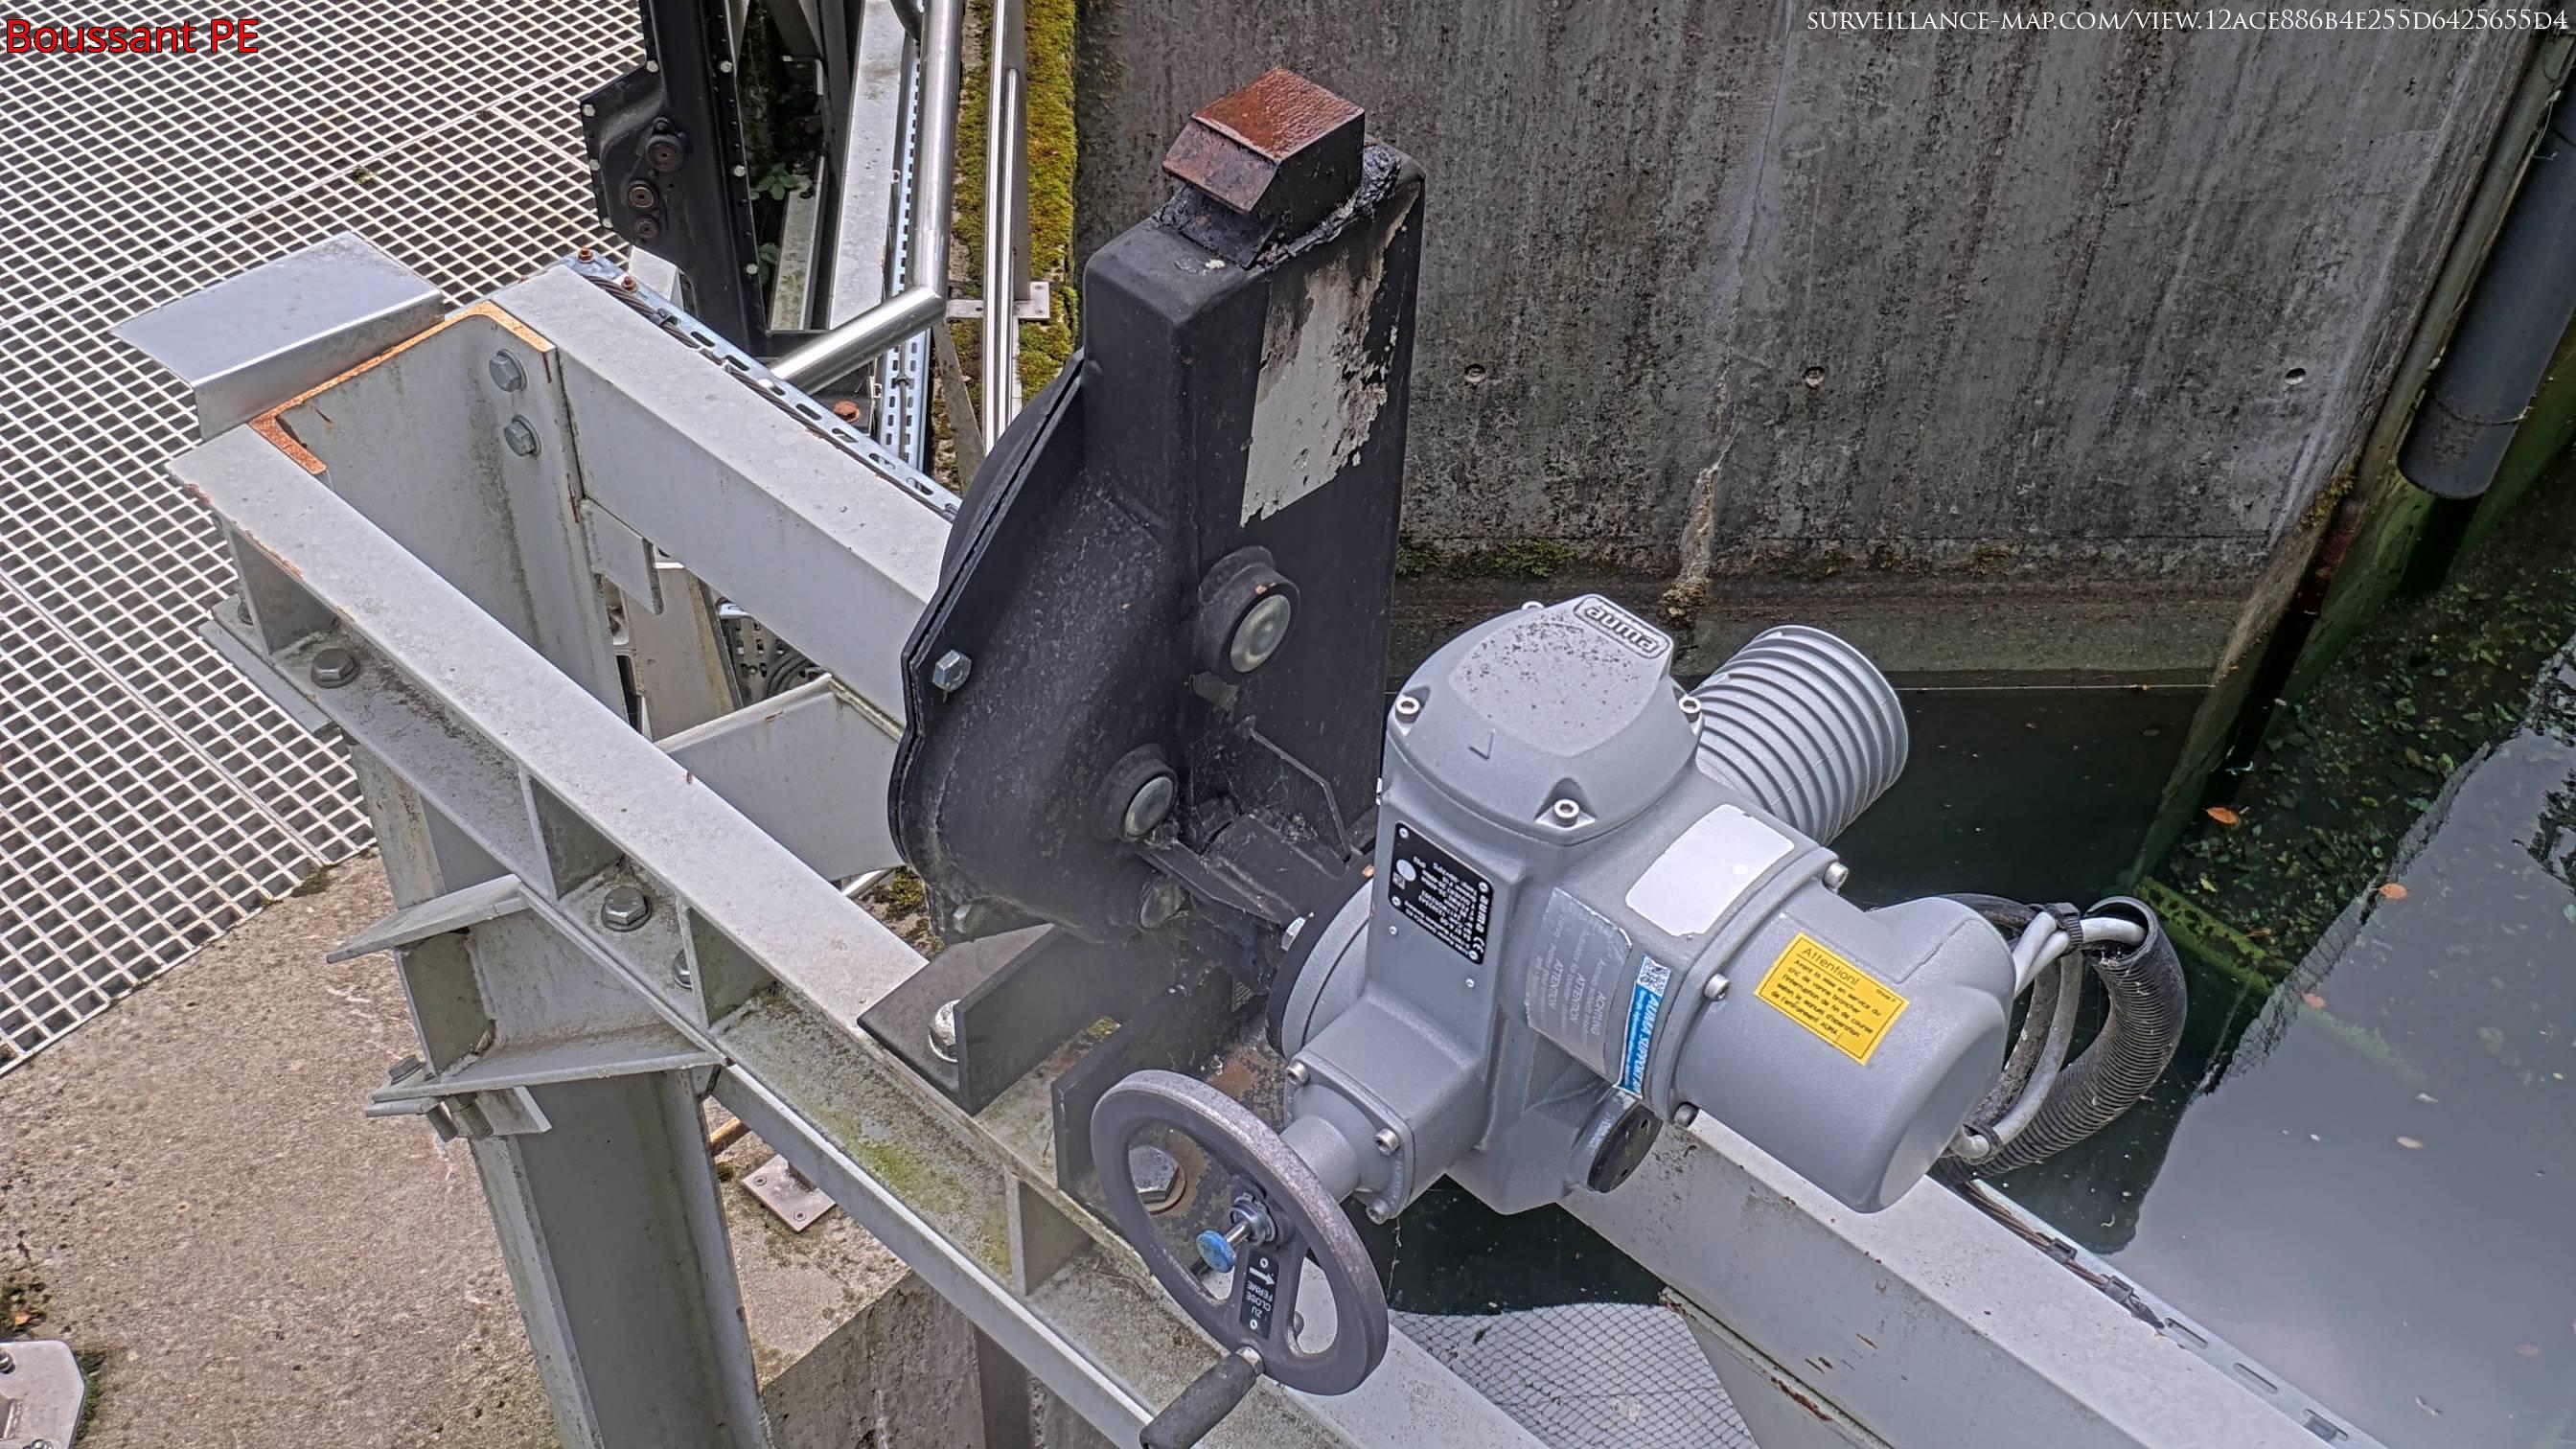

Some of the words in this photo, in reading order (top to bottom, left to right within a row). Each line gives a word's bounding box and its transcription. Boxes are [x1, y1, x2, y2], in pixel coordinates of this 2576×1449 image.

[1584, 605, 1660, 653] auma
[1475, 892, 1488, 934] auma
[1545, 956, 1564, 1010] ATTENTION
[1800, 945, 1860, 986] Attention!
[1568, 971, 1586, 1024] ATTENTION
[1770, 989, 1781, 999] de
[1792, 958, 1813, 974] Avant
[1846, 992, 1871, 1010] service
[1871, 1007, 1881, 1017] du
[1801, 974, 1811, 983] de
[1810, 981, 1831, 996] vanne
[1830, 993, 1861, 1014] brancher
[1590, 990, 1606, 1037] ACHTUNG
[1640, 992, 1659, 1035] AUMA
[1819, 997, 1829, 1006] de
[1839, 1010, 1850, 1020] de
[1850, 1017, 1873, 1034] course
[1631, 1033, 1650, 1080] SUPPORT
[1245, 1290, 1271, 1313] CLOSE
[1246, 1279, 1273, 1301] FERME
[1251, 1304, 1262, 1319] ZU
